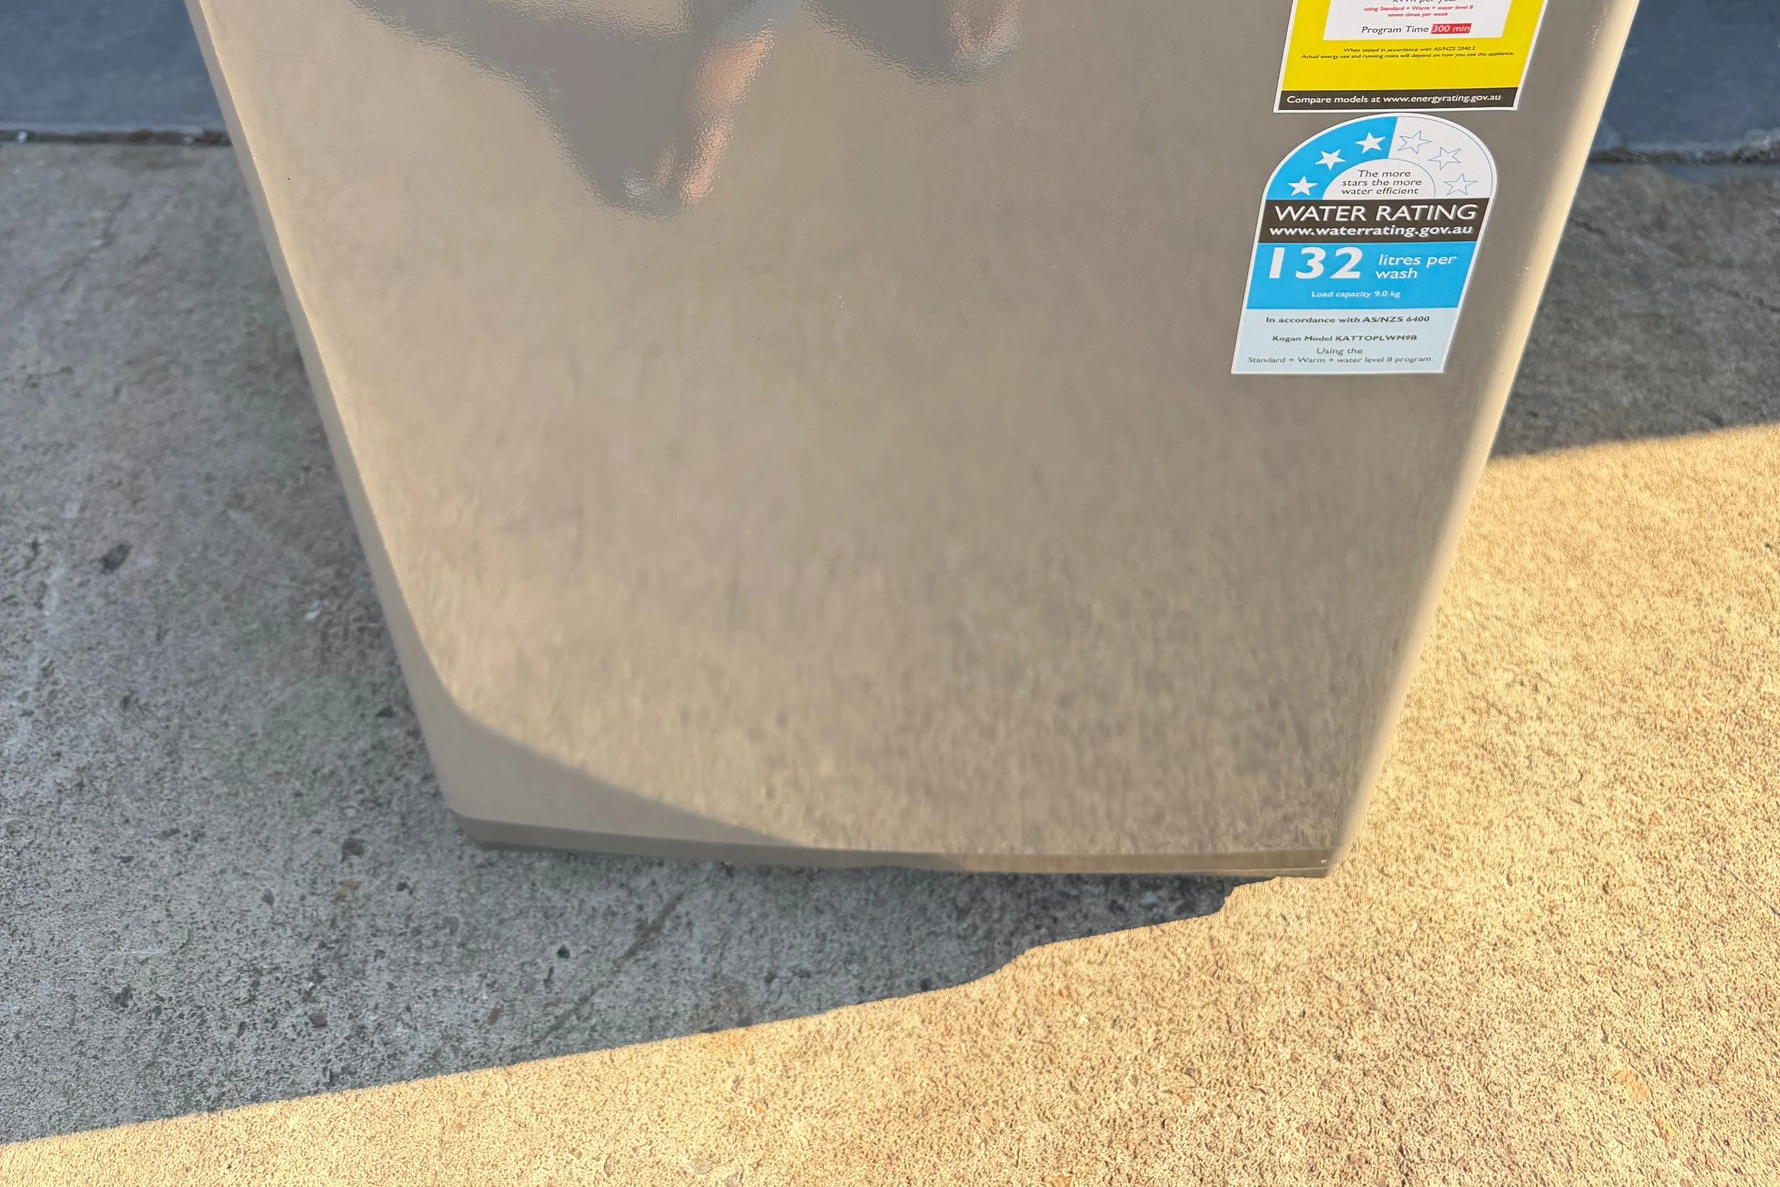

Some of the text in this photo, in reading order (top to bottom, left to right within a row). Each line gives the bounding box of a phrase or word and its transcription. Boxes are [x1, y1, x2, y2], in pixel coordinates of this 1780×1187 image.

[1361, 24, 1470, 35] Program Time 300 min
[1287, 96, 1331, 105] Compare
[1334, 95, 1368, 103] models
[1383, 94, 1501, 104] www.energyrating.gov.au
[1376, 187, 1419, 195] efficient
[1274, 204, 1478, 222] WATER RATING
[1270, 225, 1472, 238] www.waterrating.gov.au
[1268, 246, 1363, 280] 132
[1378, 254, 1456, 267] litres per
[1376, 268, 1417, 279] wash
[1336, 291, 1371, 299] capacity
[1316, 347, 1344, 356] Using
